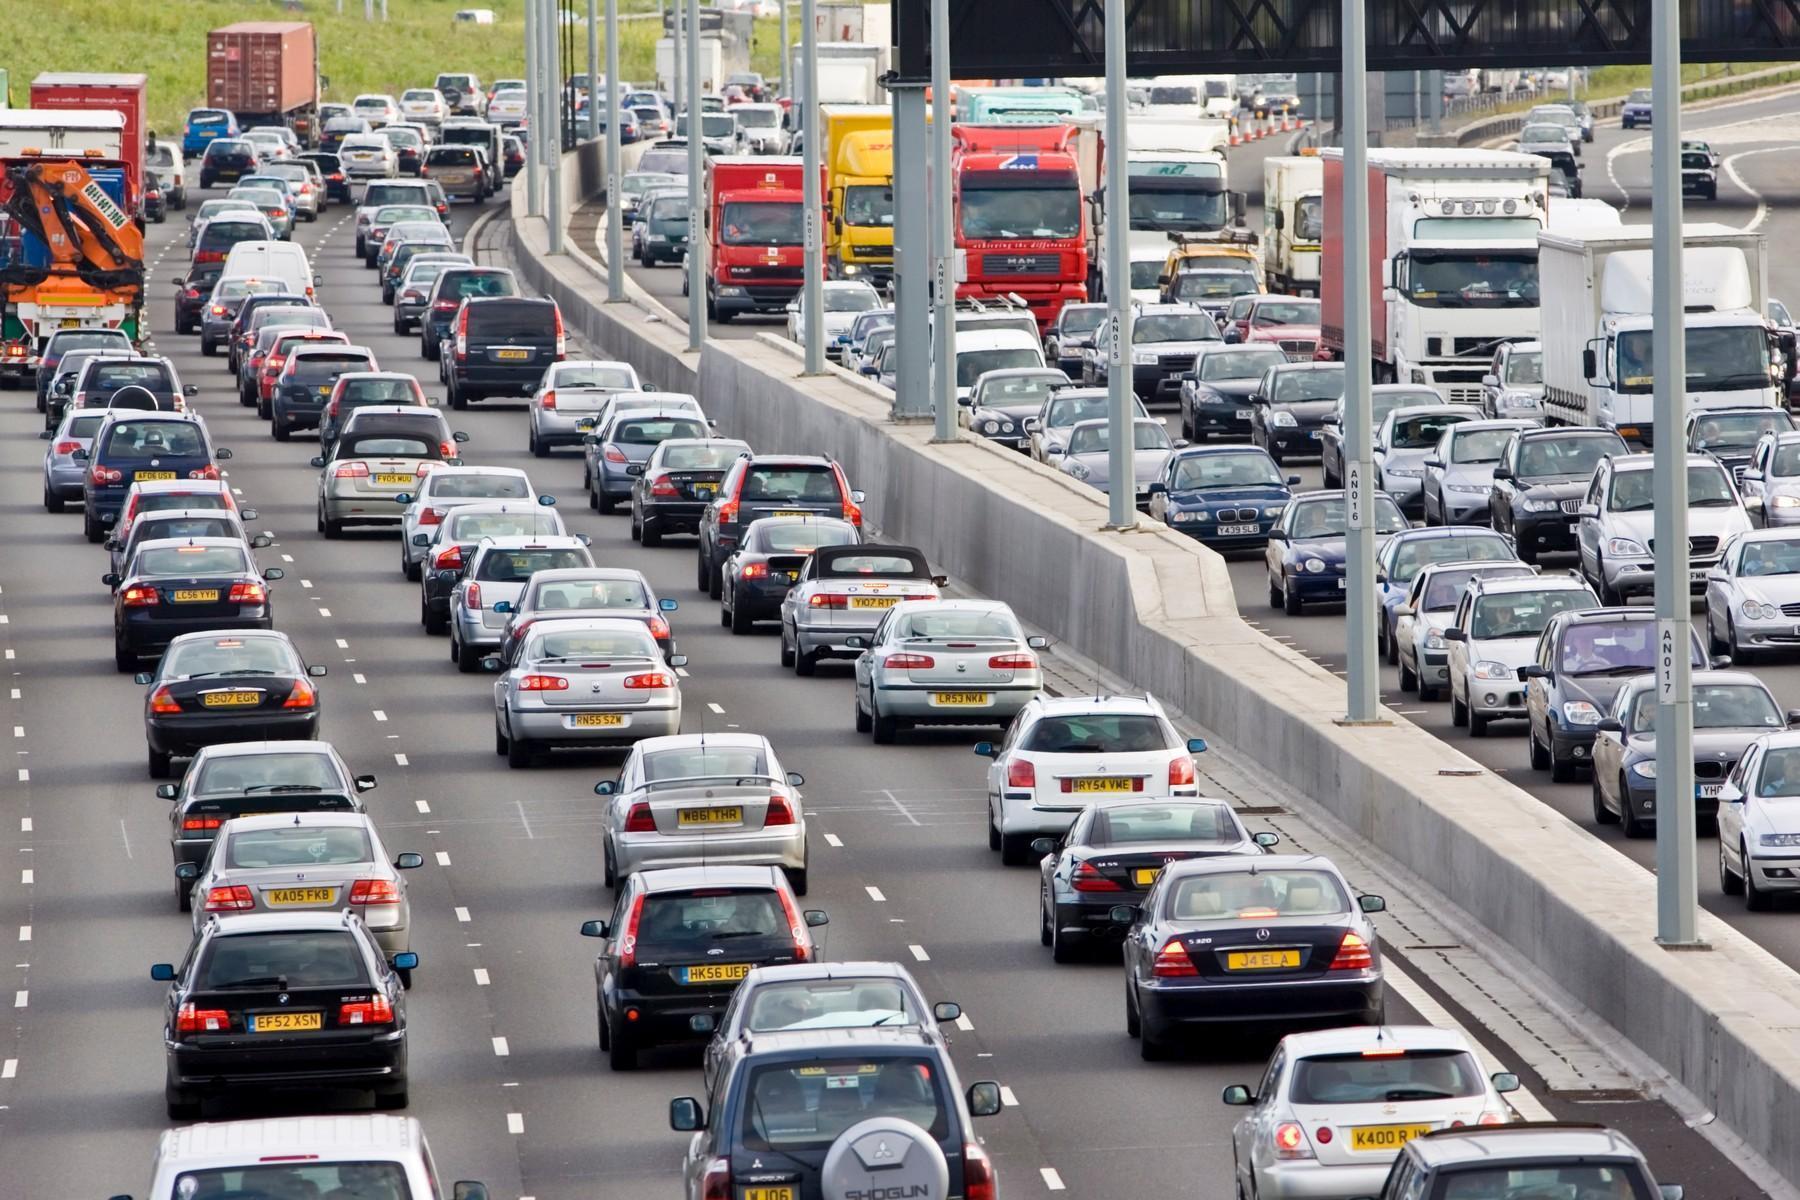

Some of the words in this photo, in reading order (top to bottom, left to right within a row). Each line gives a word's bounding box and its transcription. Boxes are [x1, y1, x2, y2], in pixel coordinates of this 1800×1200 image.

[1350, 469, 1359, 521] AN016
[1218, 526, 1240, 535] Y439
[1241, 525, 1260, 534] SLB
[176, 590, 199, 600] LC56
[200, 589, 217, 599] YYH
[855, 598, 875, 607] Y107
[1662, 630, 1672, 694] AN017
[206, 694, 234, 704] S507
[236, 692, 259, 702] EGK
[940, 694, 964, 703] LR53
[965, 693, 984, 703] NKA
[576, 715, 601, 725] RN55
[1079, 780, 1106, 790] RY54
[711, 807, 737, 819] THR
[274, 890, 305, 902] KA05
[1239, 955, 1260, 967] J4
[1261, 953, 1289, 966] ELA
[690, 967, 722, 979] HK56
[258, 1016, 292, 1028] EF52
[293, 1014, 318, 1027] XSN
[1356, 1131, 1396, 1145] K400
[844, 1184, 929, 1200] SHOGUN
